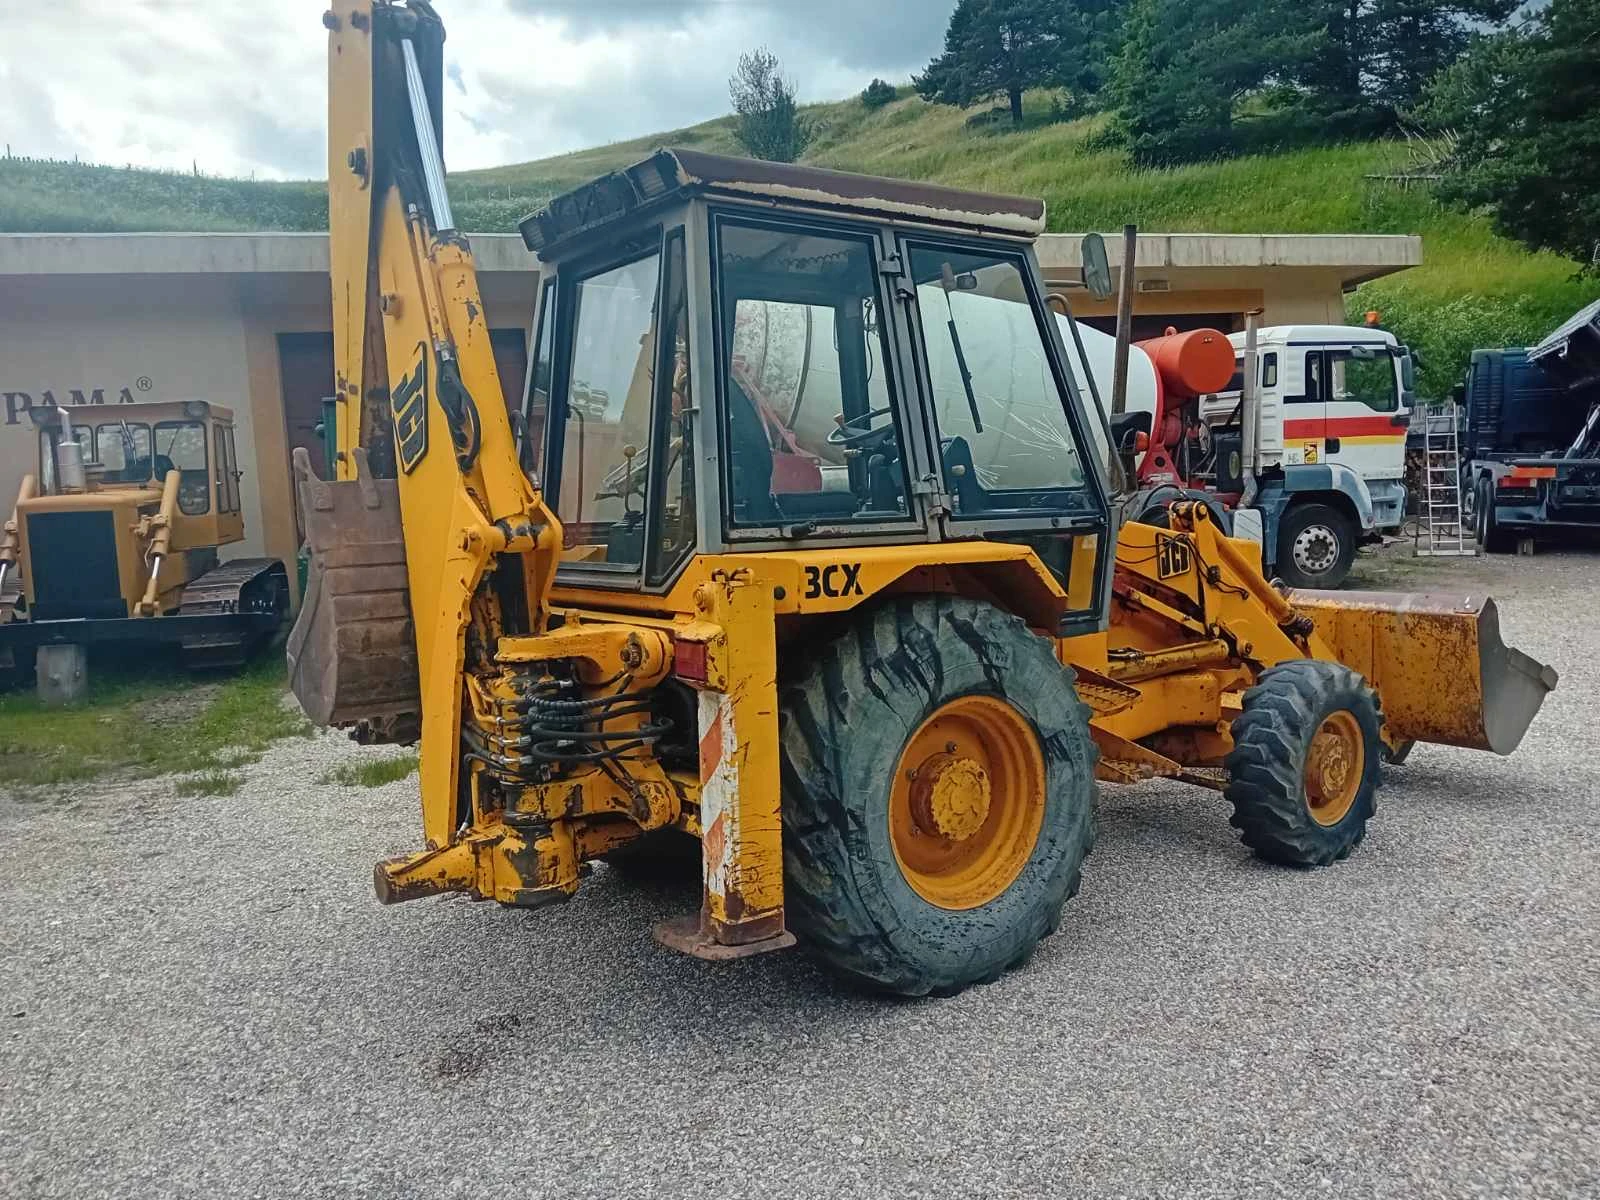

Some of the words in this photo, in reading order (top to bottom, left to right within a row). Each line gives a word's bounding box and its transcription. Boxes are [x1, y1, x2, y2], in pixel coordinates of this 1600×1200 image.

[391, 359, 424, 465] JCB
[1160, 537, 1190, 578] JCB
[804, 562, 864, 599] 3CX
